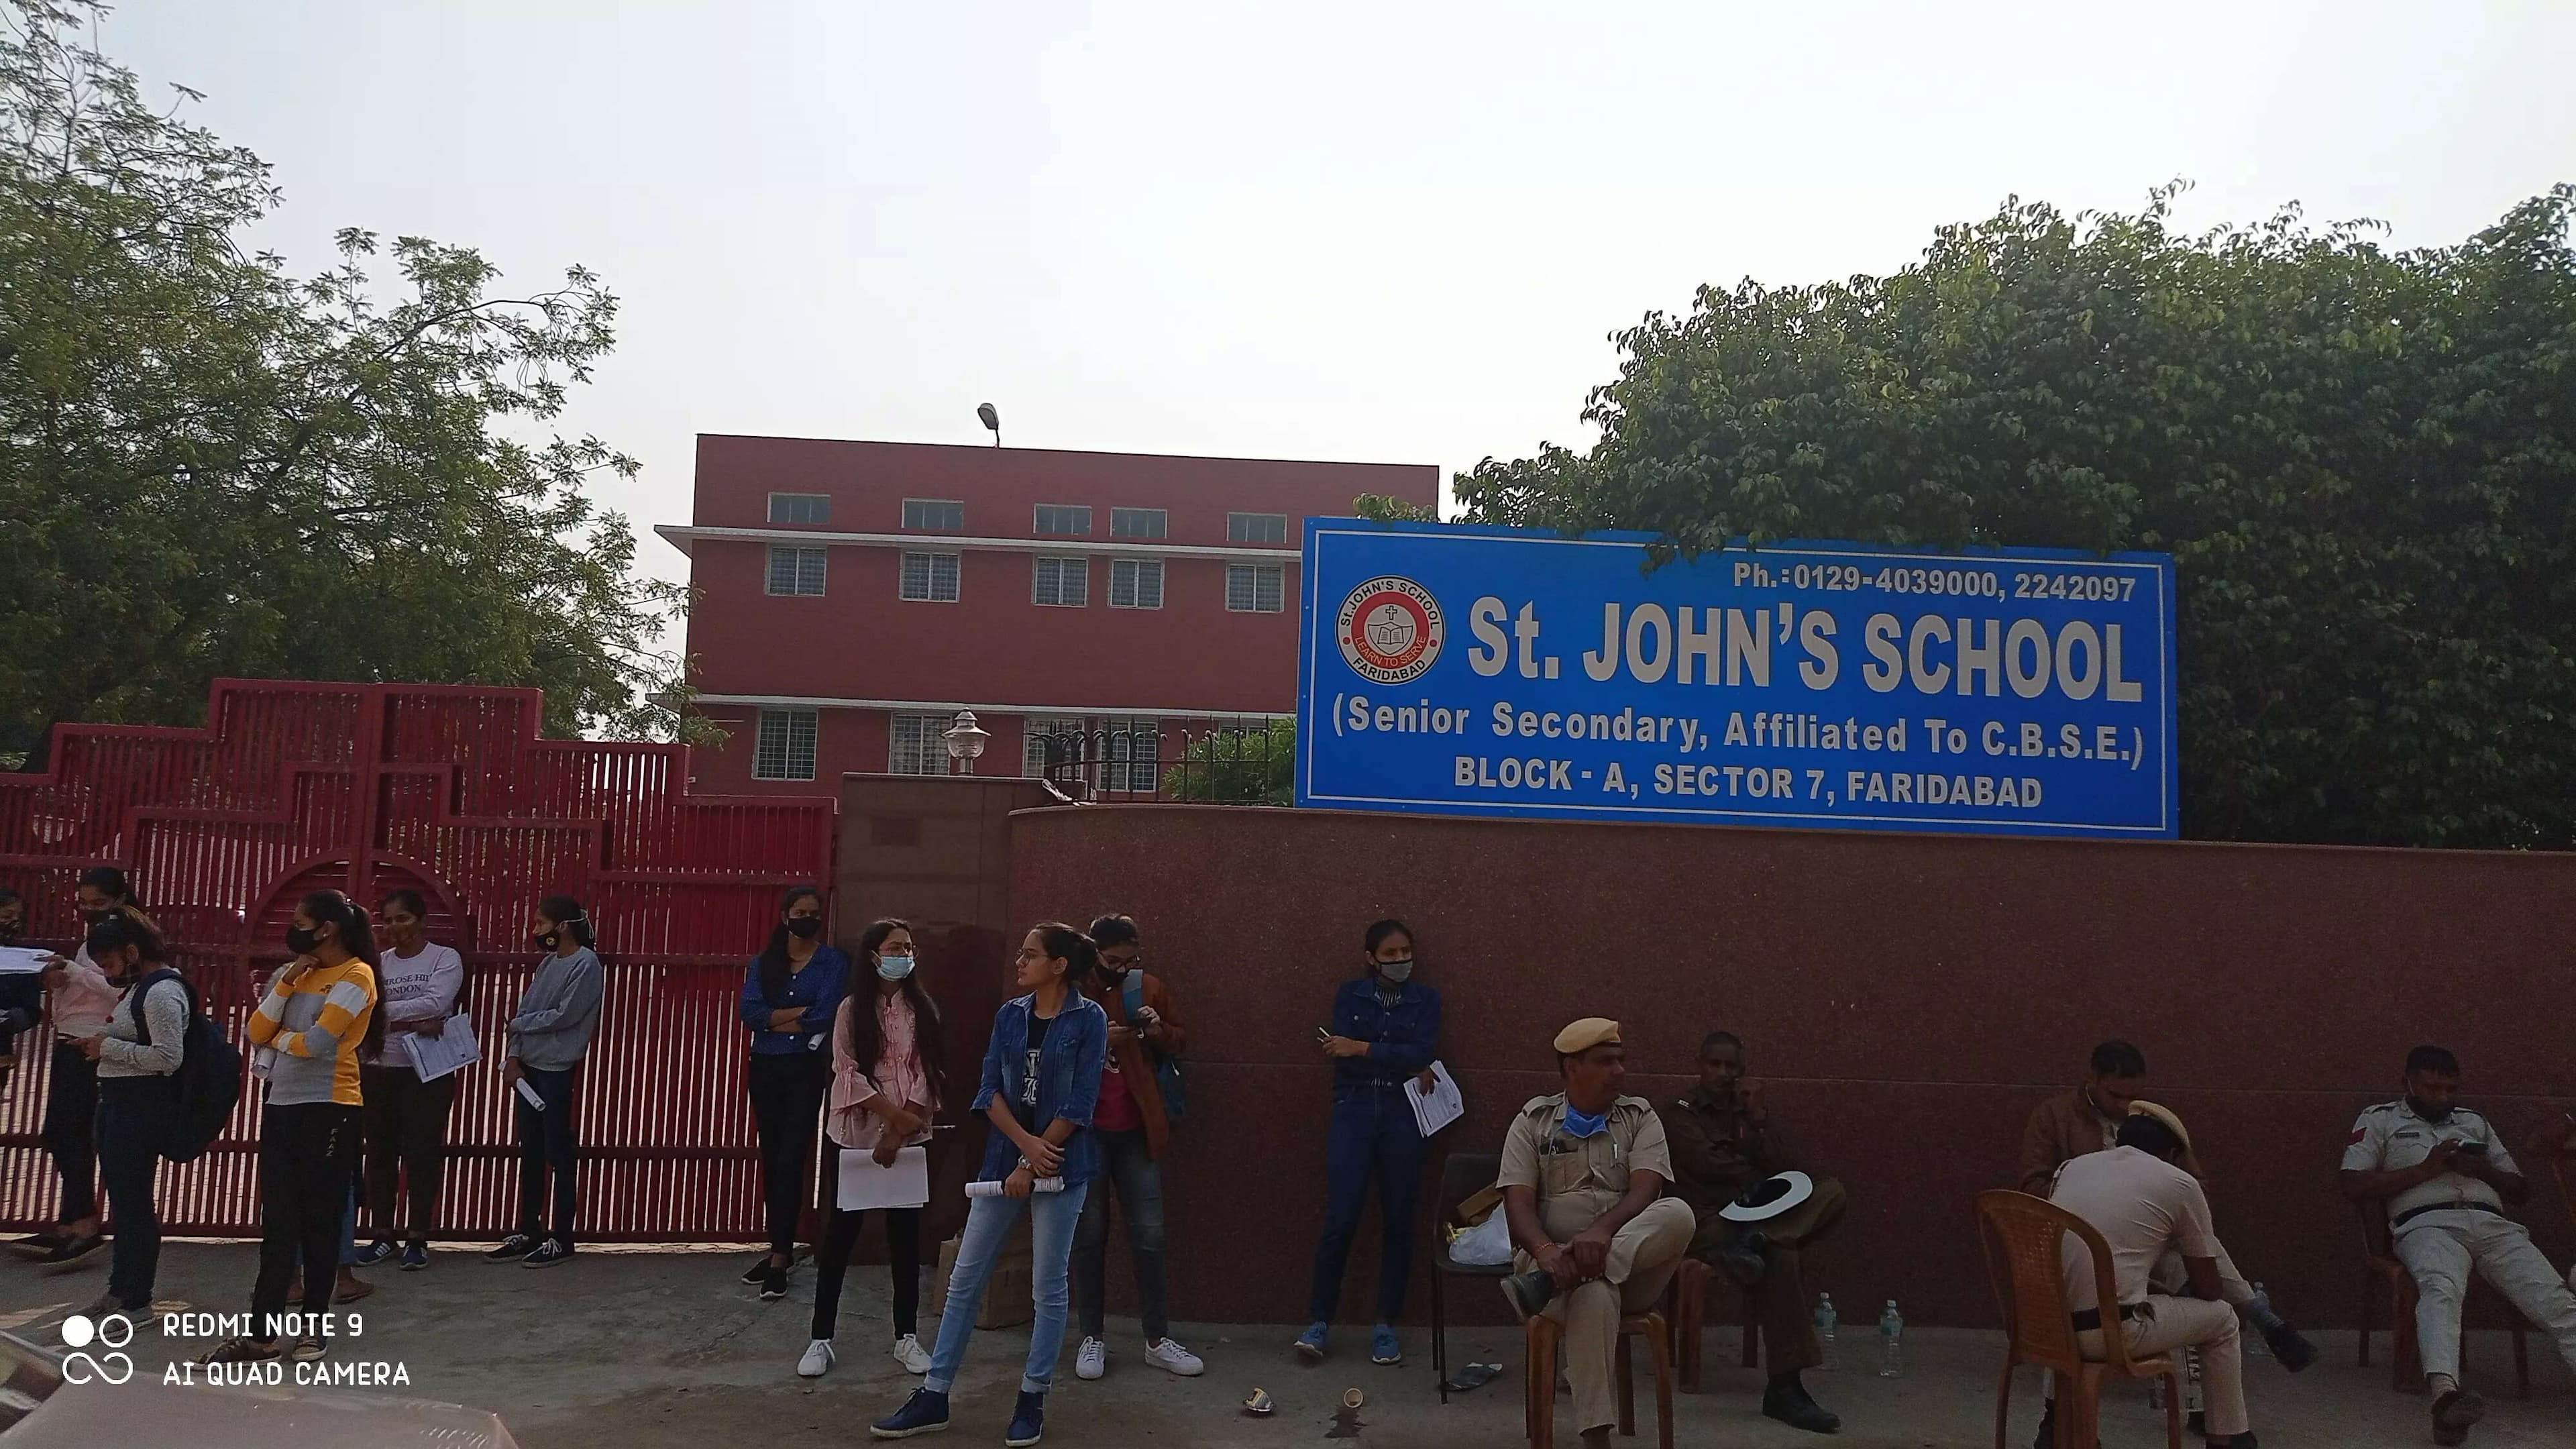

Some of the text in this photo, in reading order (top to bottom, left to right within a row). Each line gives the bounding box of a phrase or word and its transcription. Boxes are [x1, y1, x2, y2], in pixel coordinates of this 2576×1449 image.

[1399, 582, 1440, 629] SCHOOL
[2014, 574, 2136, 602] 2242097
[1355, 635, 1427, 667] LEARN TO SERVE
[1467, 596, 1560, 680] St.
[1862, 612, 2143, 703] SCHOOL
[1352, 659, 1426, 681] FARIDABAD
[1332, 692, 2143, 771] (Senior Secondary, Affiliated To C.B.S.E.)
[1454, 755, 1572, 791] BLOCK
[1602, 761, 1639, 801] A,
[1653, 763, 1794, 799] SECTOR
[1805, 769, 1835, 808] 7,
[1847, 771, 2042, 808] FARIDABAD
[385, 984, 421, 996] ONDON
